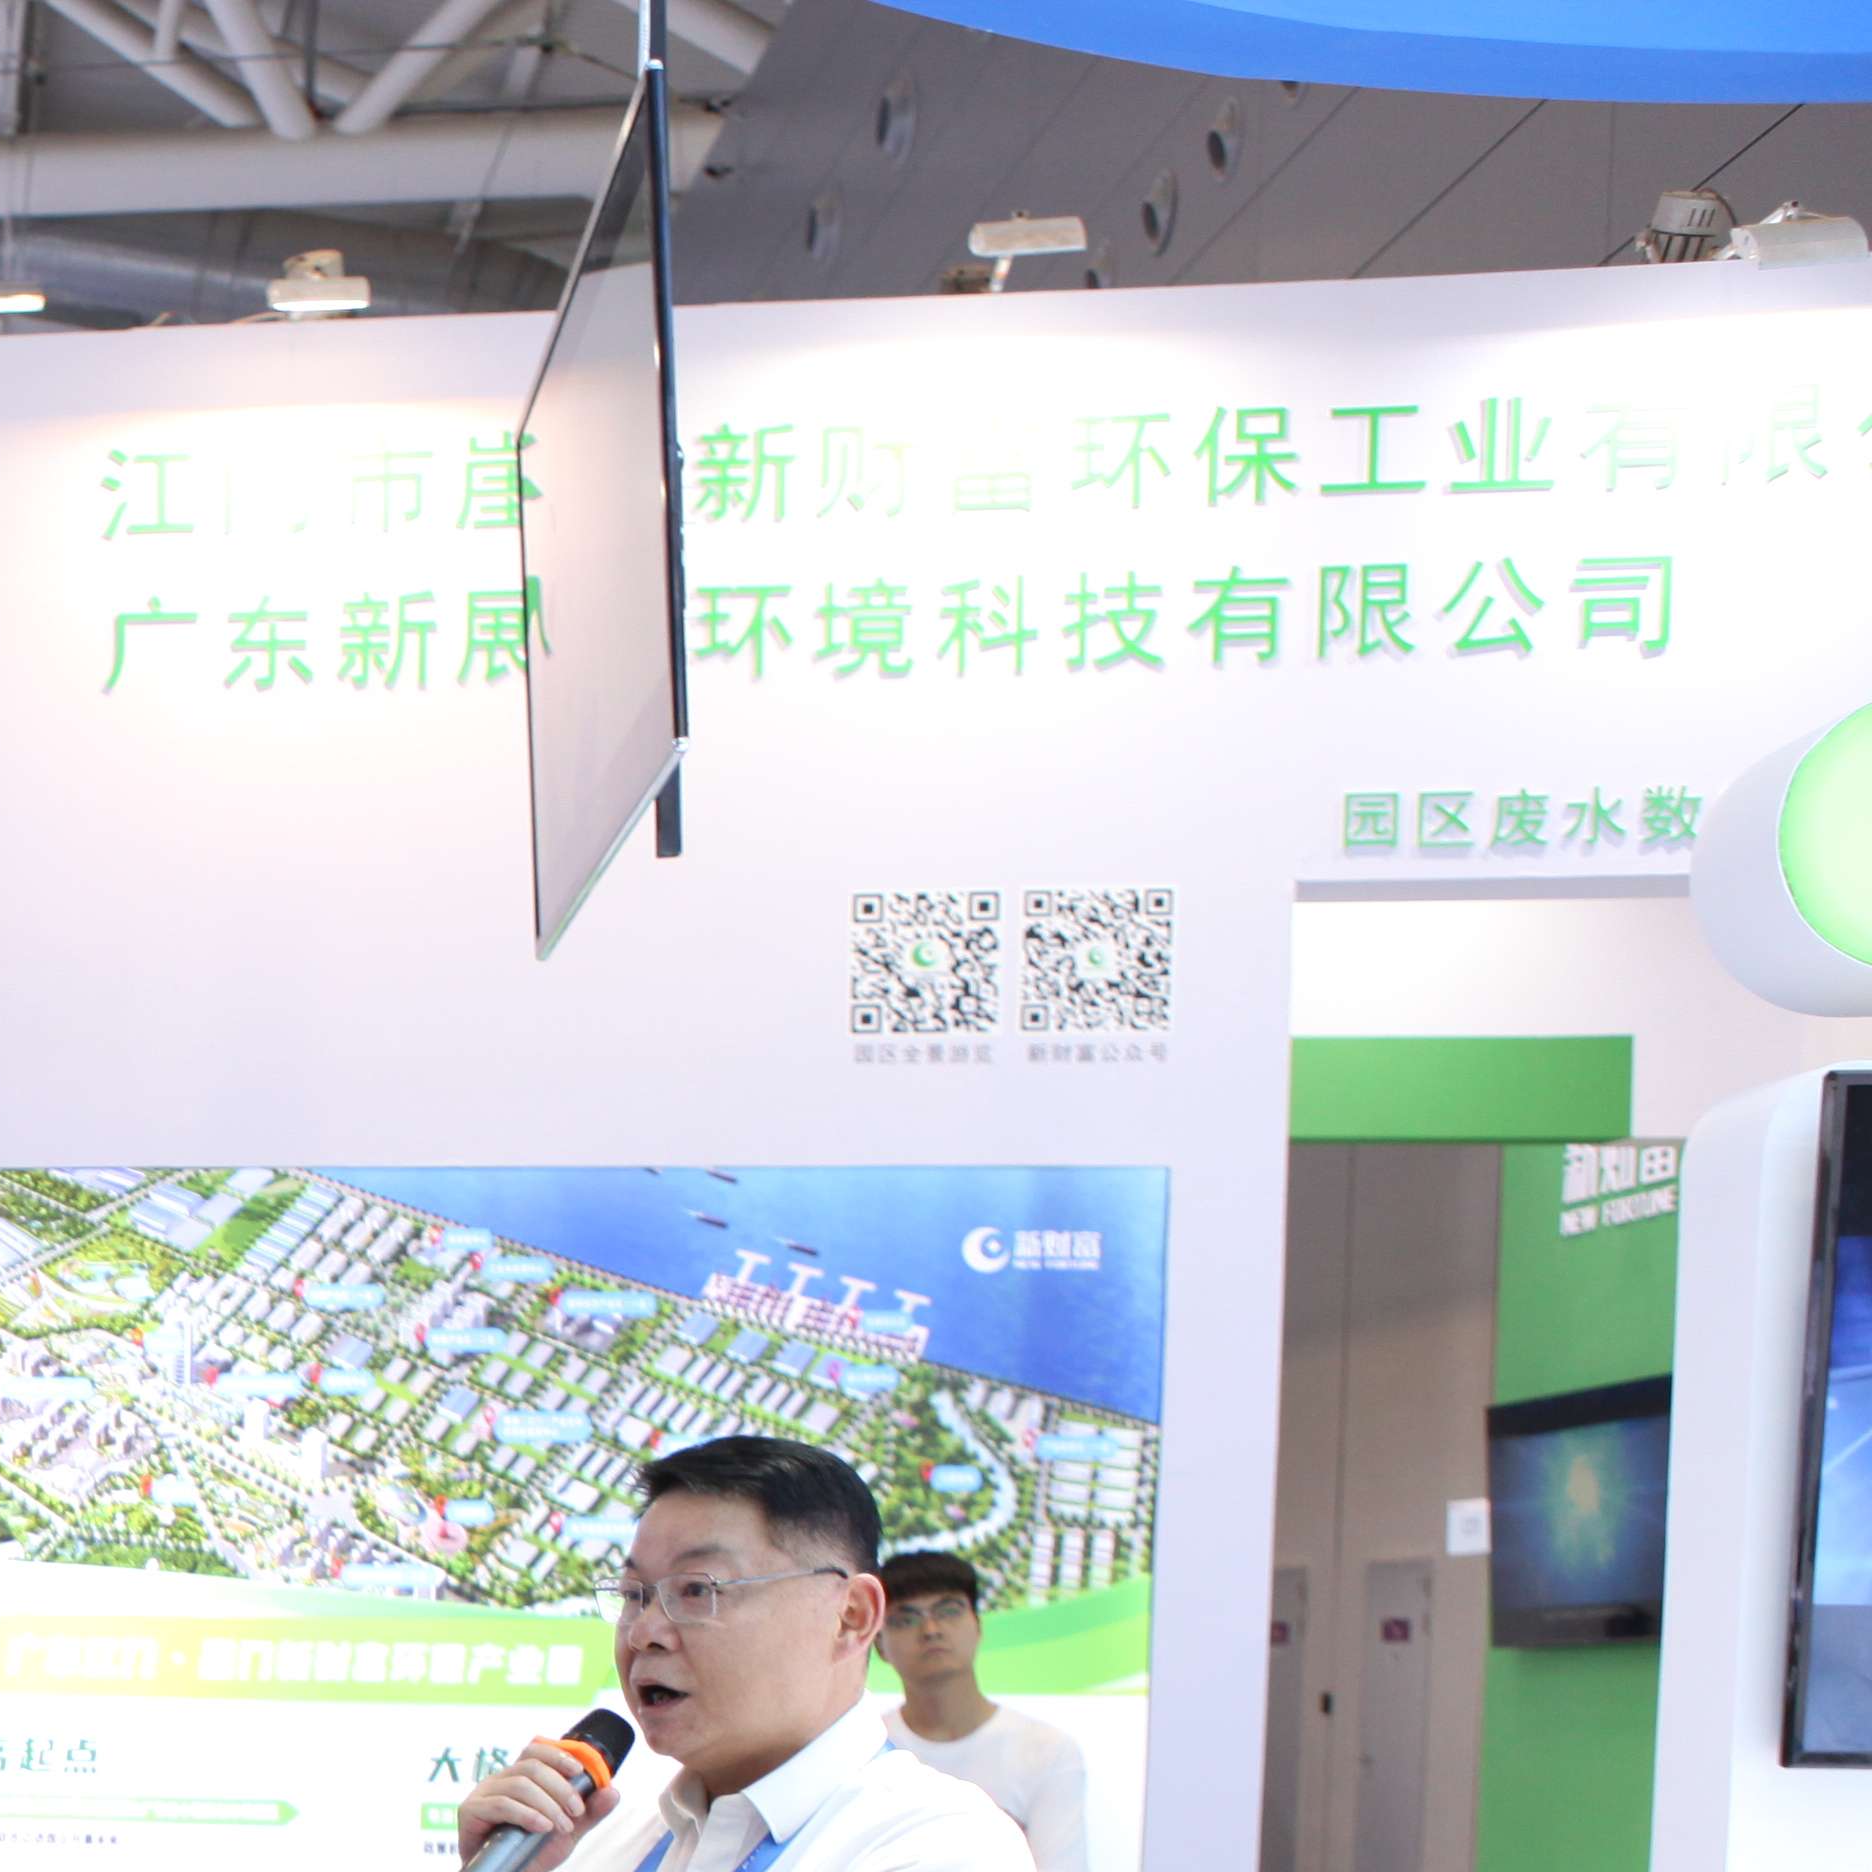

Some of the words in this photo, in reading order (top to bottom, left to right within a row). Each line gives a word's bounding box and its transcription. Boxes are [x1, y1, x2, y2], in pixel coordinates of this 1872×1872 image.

[102, 553, 1676, 694] 广东新展环境科技有限公司
